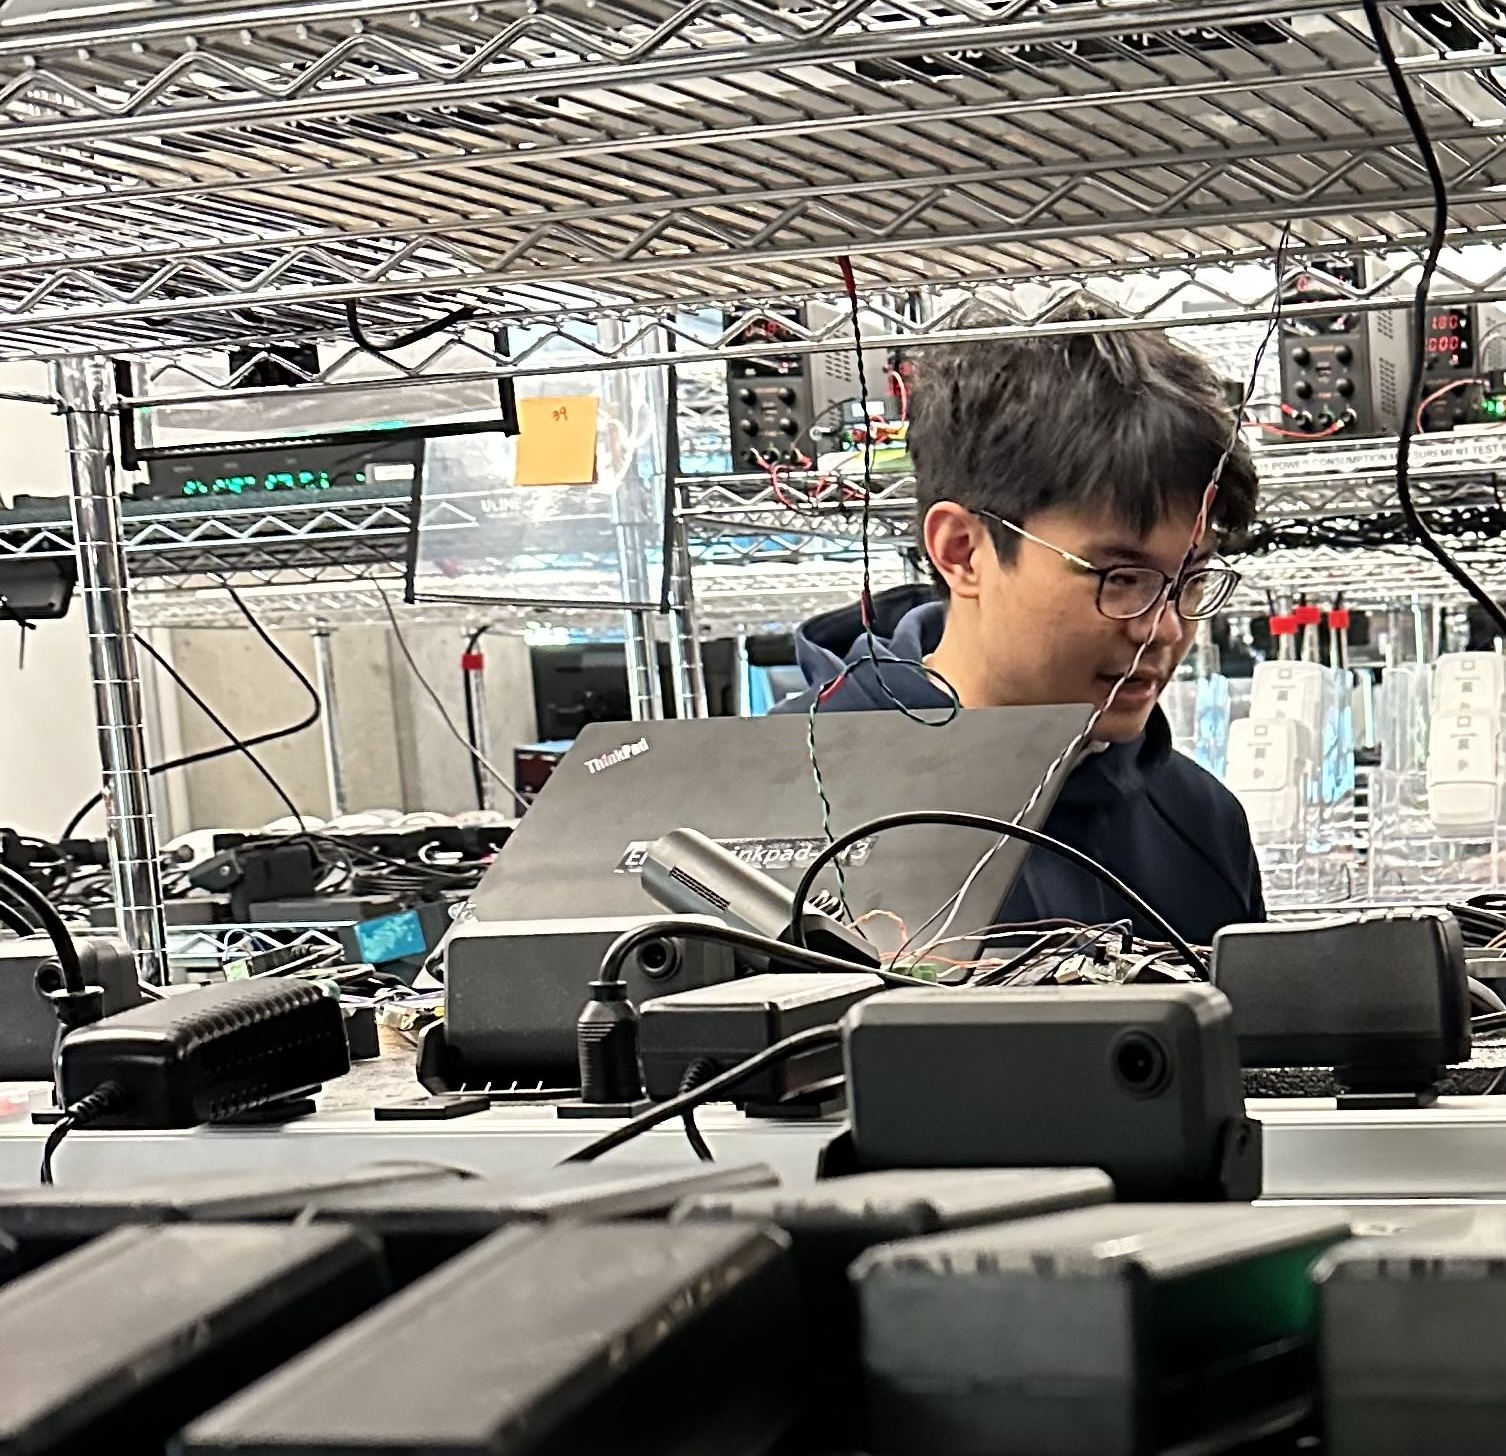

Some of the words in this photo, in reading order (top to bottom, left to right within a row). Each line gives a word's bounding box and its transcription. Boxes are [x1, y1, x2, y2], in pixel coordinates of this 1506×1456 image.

[1272, 458, 1309, 471] POWER
[1311, 453, 1387, 467] CONSUMPTION
[1473, 443, 1499, 455] TEST
[583, 737, 650, 774] ThinkPad
